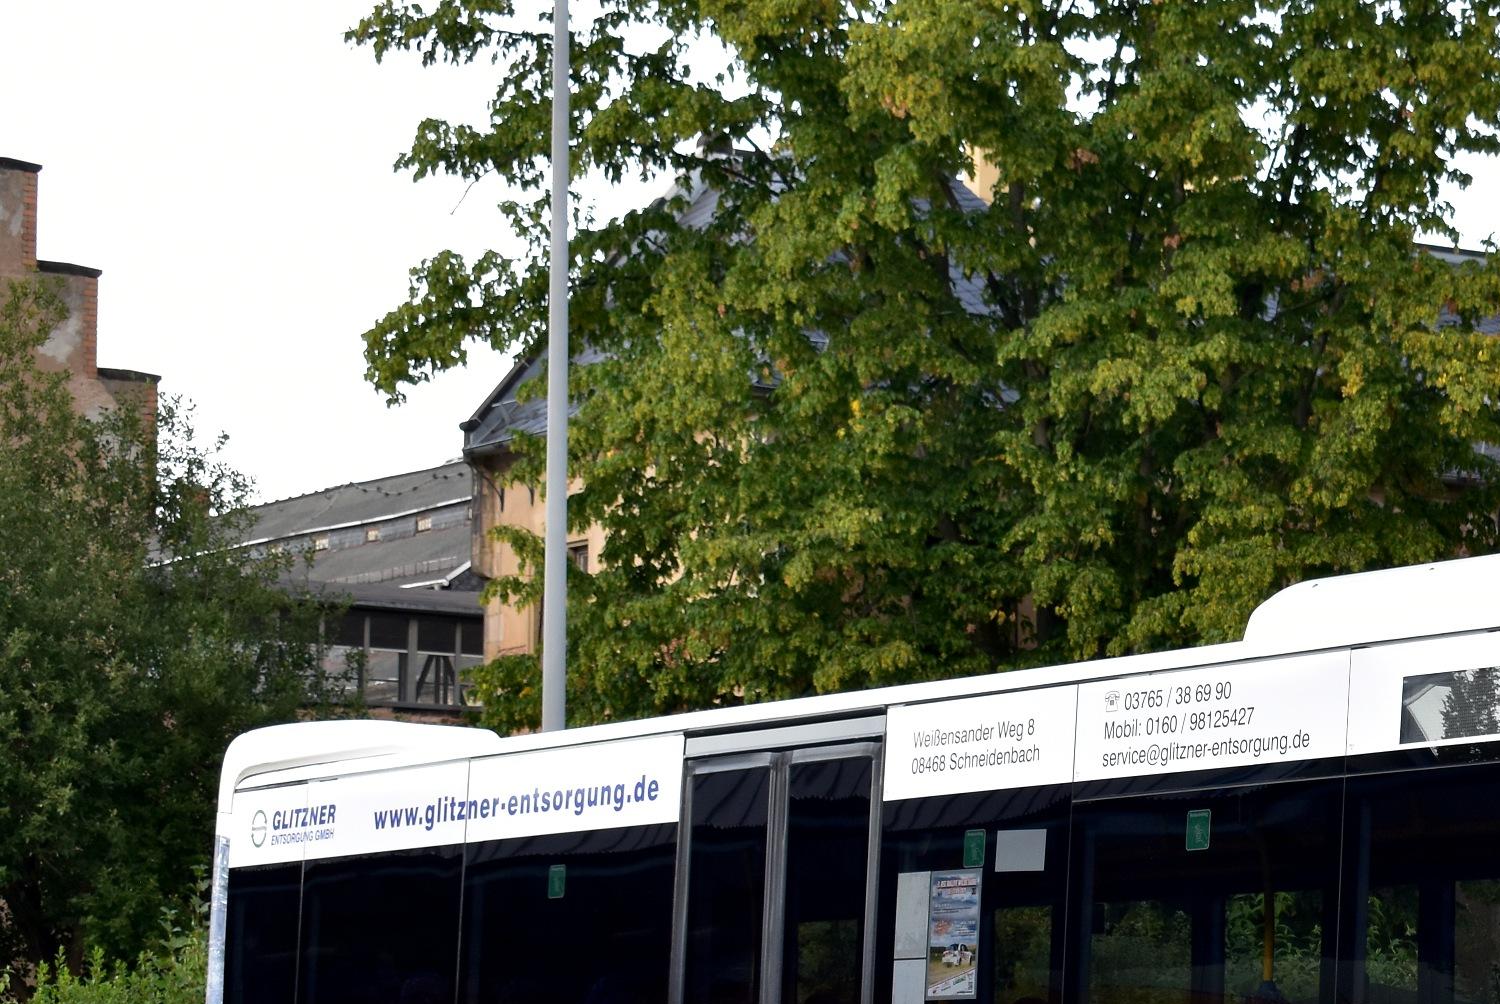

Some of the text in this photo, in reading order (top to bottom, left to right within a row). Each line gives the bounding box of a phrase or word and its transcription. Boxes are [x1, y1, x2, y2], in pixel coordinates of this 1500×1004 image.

[1124, 681, 1232, 711] 03765 / 38 69 90
[913, 718, 1035, 749] Weißensander Weg 8
[1104, 706, 1255, 740] Mobil: 0160 / 98125427
[911, 744, 1040, 775] 08468 Schneidenbach
[1102, 729, 1311, 768] service@glitzner-entsorgung.de
[272, 804, 336, 831] GLITZNER
[374, 774, 660, 832] www.glitzner-entsorgung.de
[271, 830, 314, 846] ENTSORGUNG
